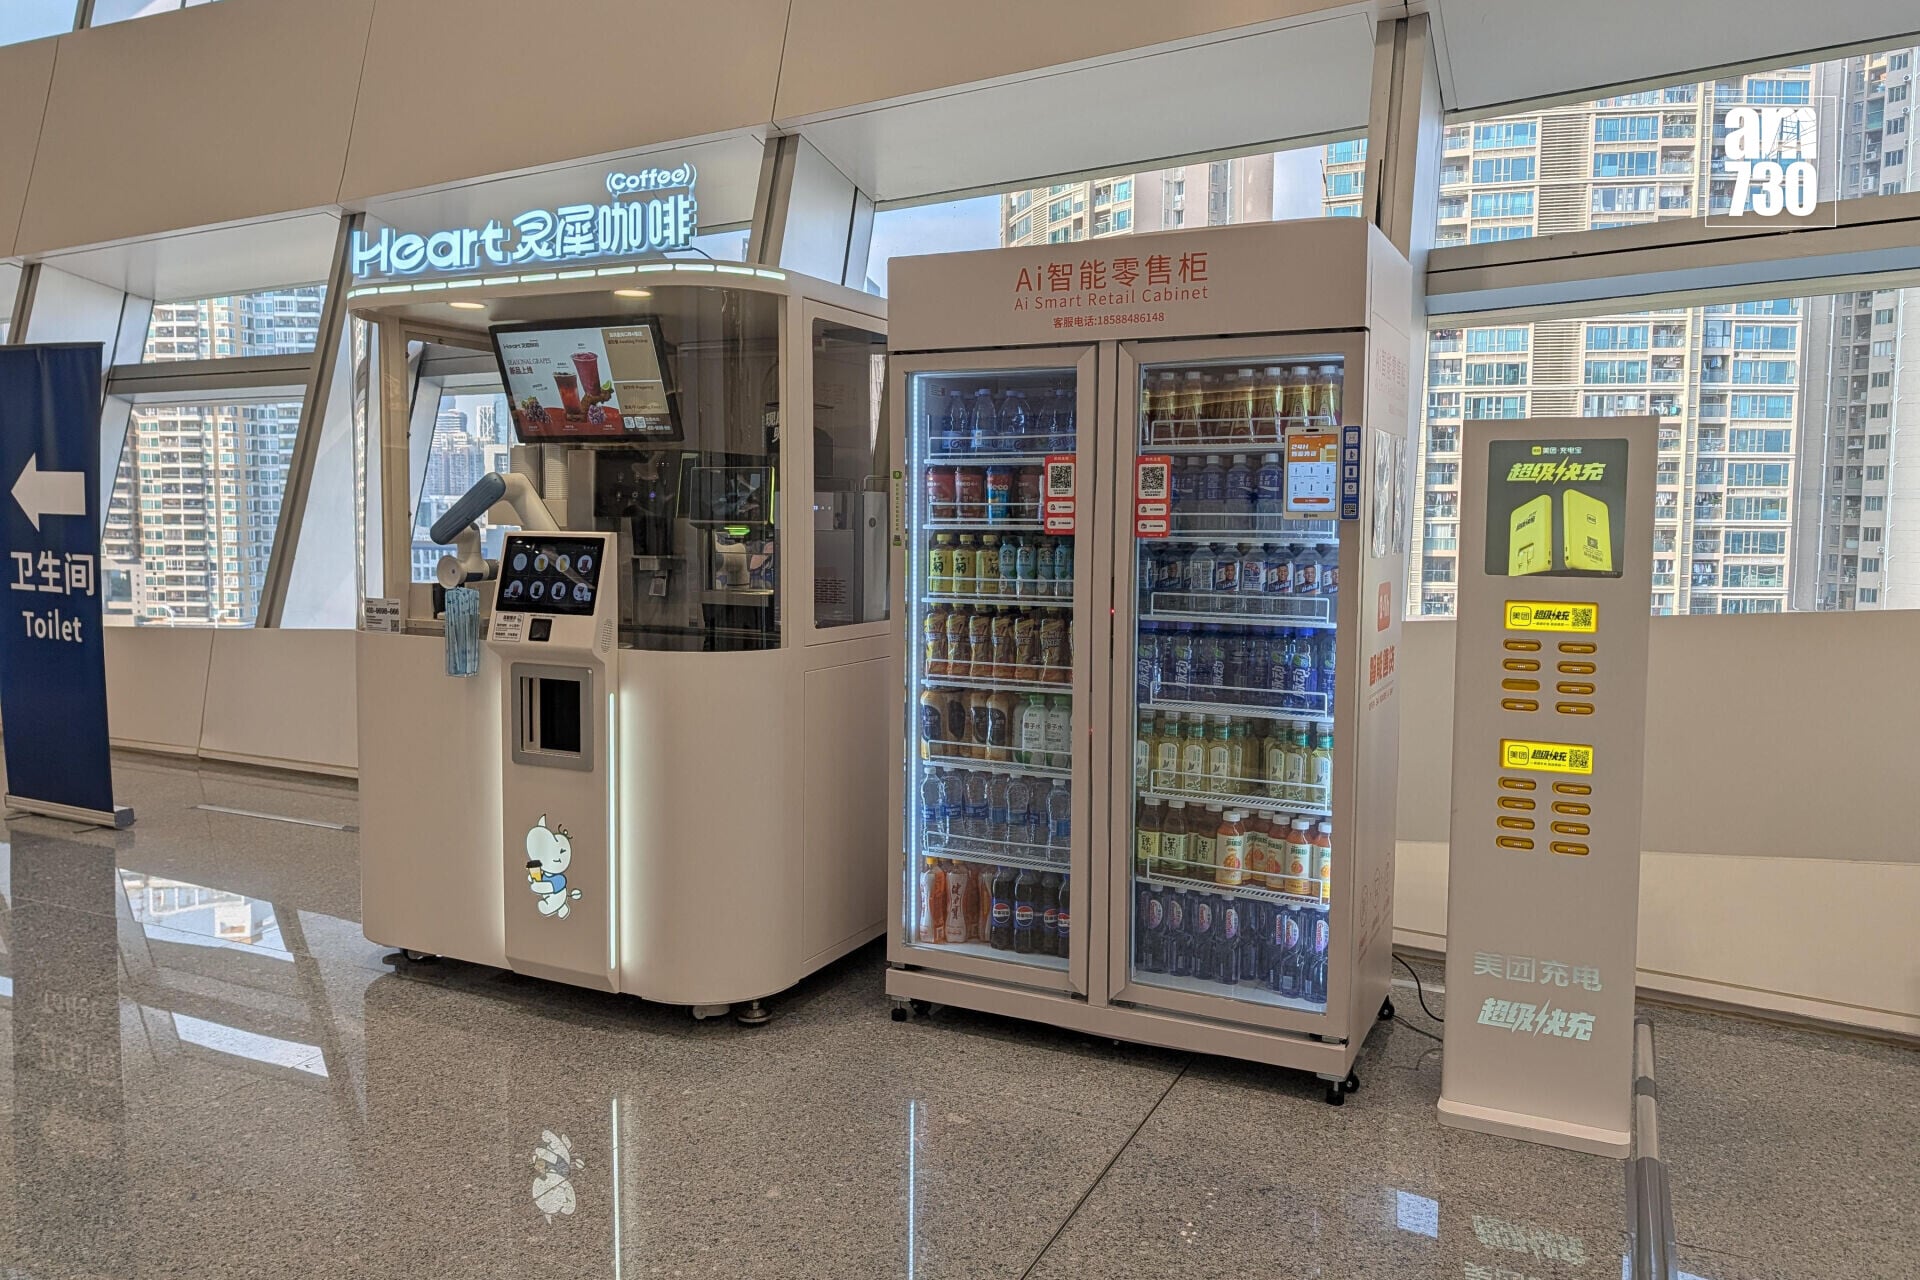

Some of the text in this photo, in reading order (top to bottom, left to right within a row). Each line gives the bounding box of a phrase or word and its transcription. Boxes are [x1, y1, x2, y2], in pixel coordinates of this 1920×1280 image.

[353, 220, 504, 275] Heart
[1015, 252, 1209, 293] Ai智能零售柜
[1014, 285, 1209, 312] Ai Smart Retail Cabinet
[1506, 461, 1607, 485] 超级快充
[10, 550, 95, 596] 卫生间
[22, 608, 83, 643] Toilet
[1473, 950, 1603, 993] 美团充电
[1477, 997, 1596, 1041] 超级快充
